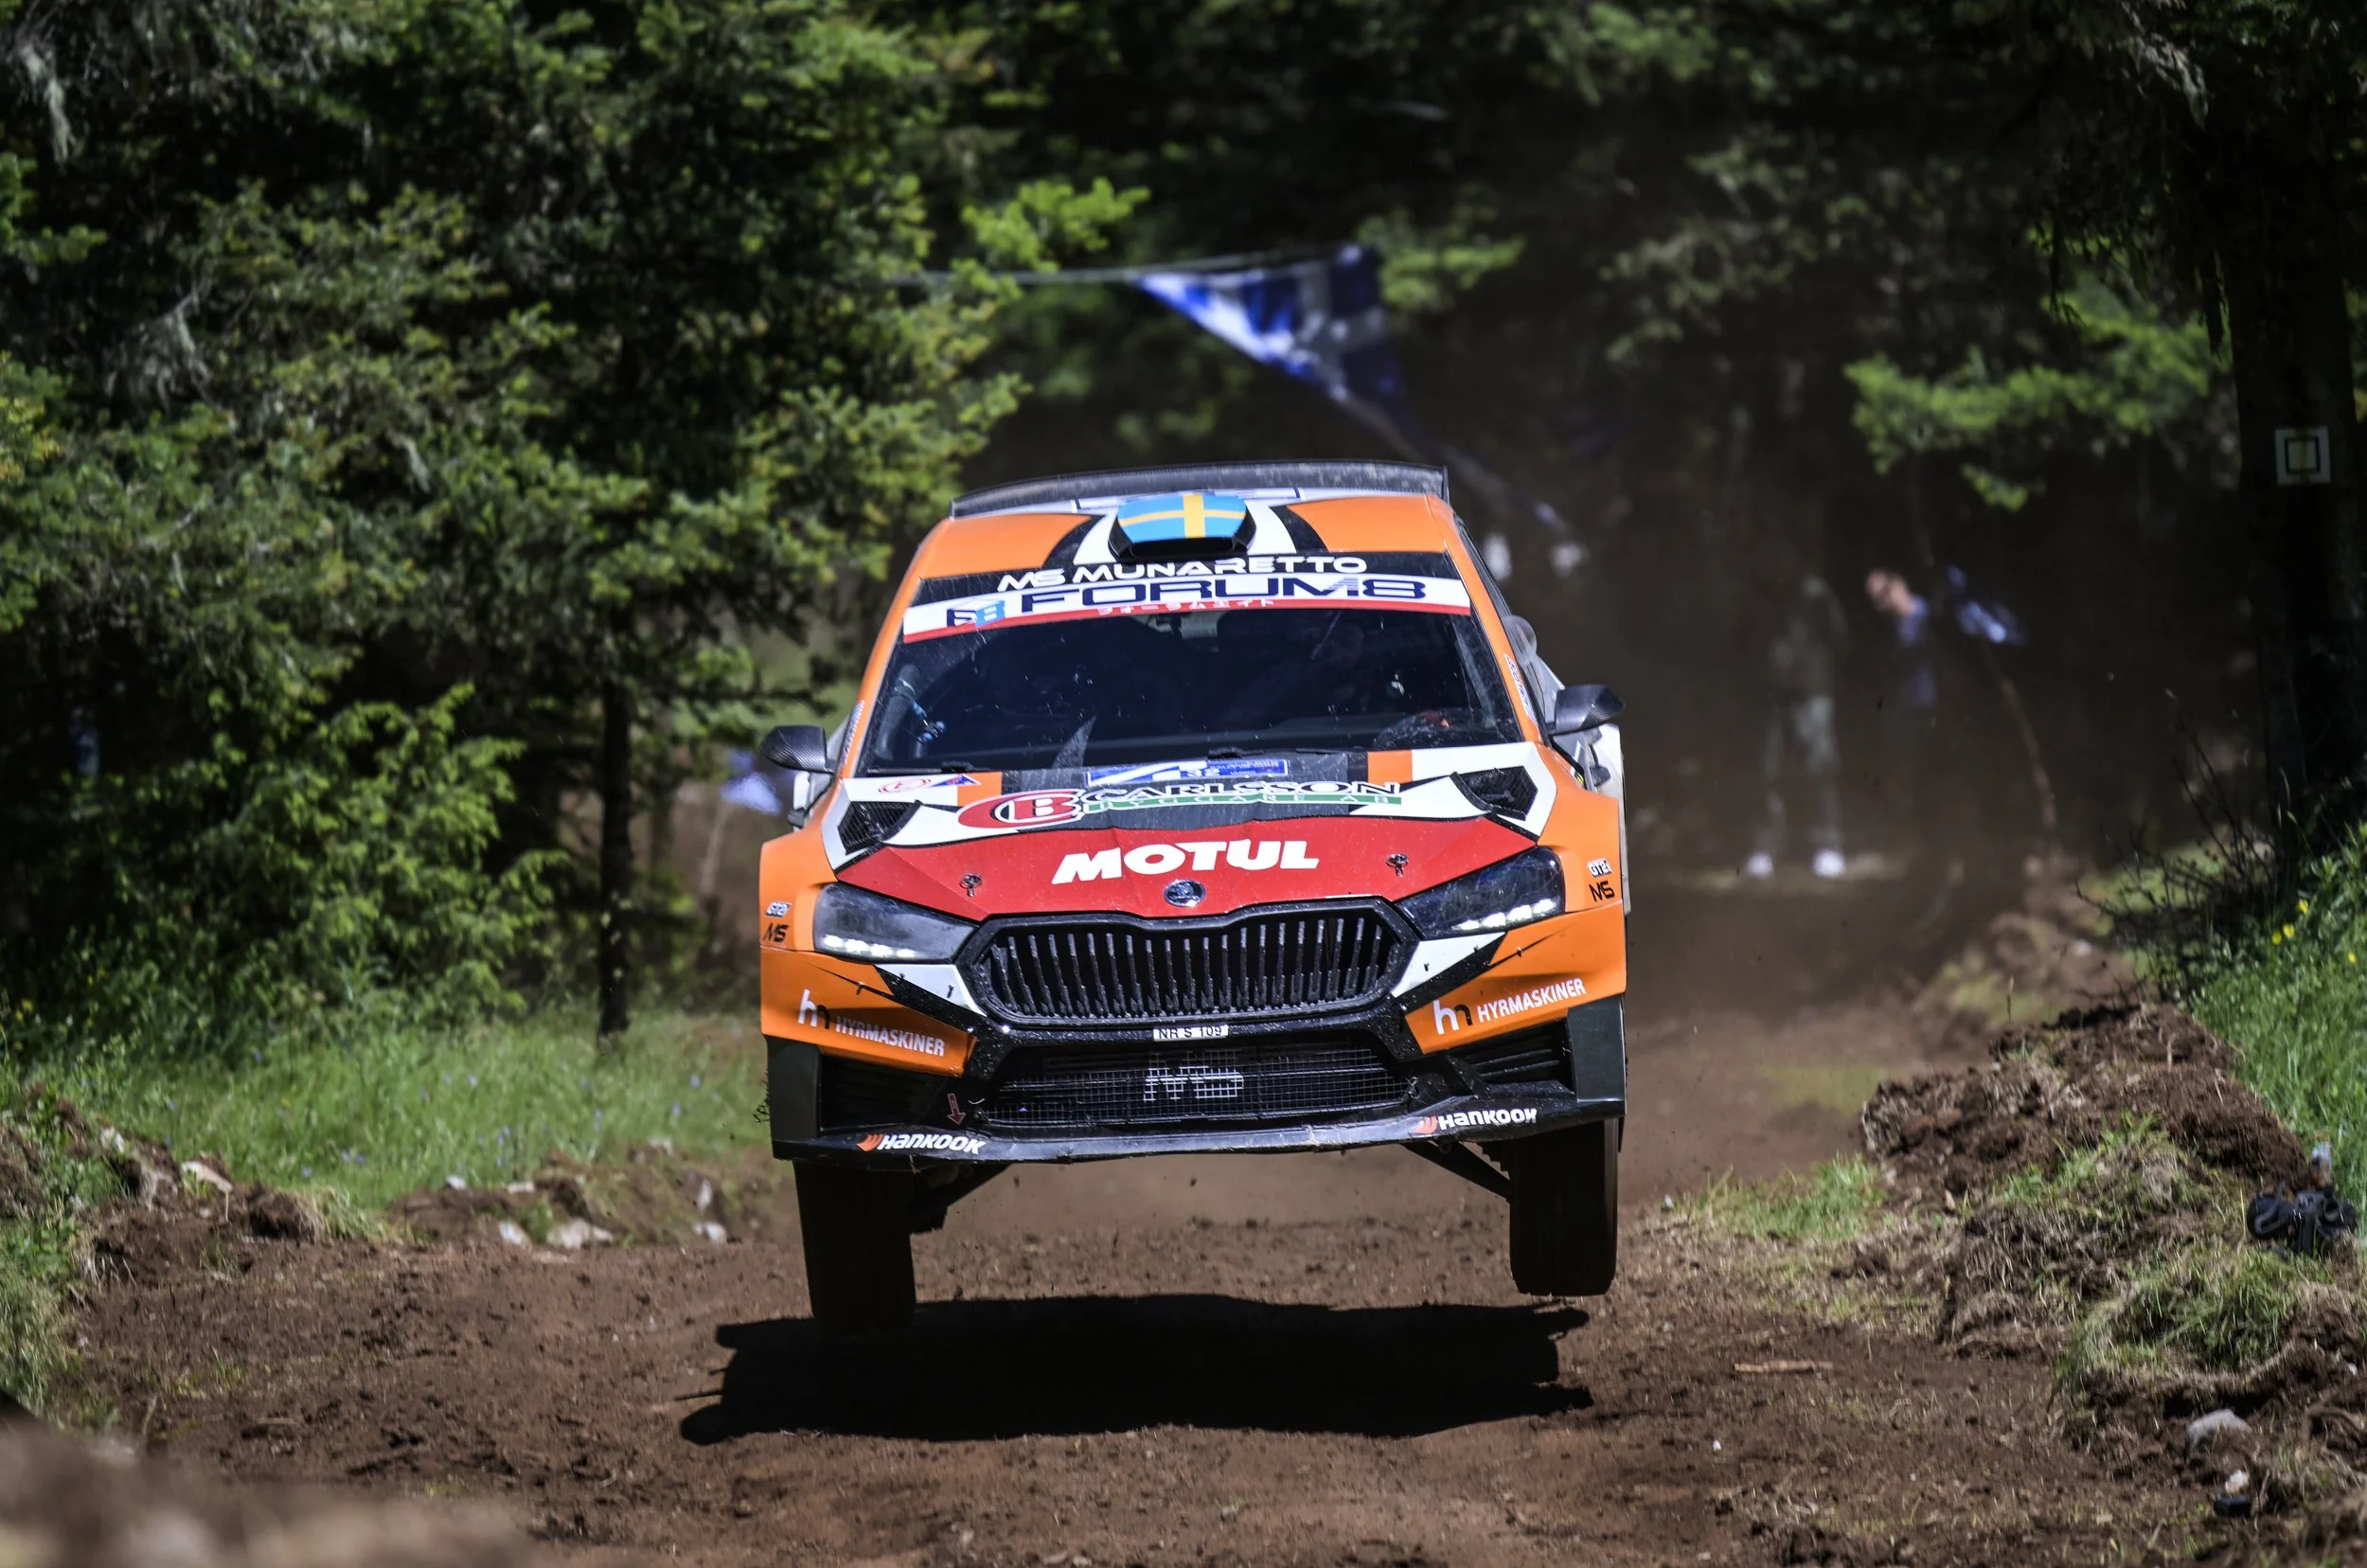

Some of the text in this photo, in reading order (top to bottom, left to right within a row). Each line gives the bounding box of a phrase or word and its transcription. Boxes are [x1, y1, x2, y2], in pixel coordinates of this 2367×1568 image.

[997, 556, 1367, 592] MS MUNARETTO
[1022, 577, 1426, 614] FORUM8
[1080, 780, 1400, 804] CARLSSON
[1051, 839, 1320, 884] MOTUL
[1589, 881, 1615, 901] MS
[1477, 977, 1587, 1024] HYRMASKINER
[835, 1015, 945, 1057] HYRMASKINER
[1159, 1025, 1222, 1039] NR S 109
